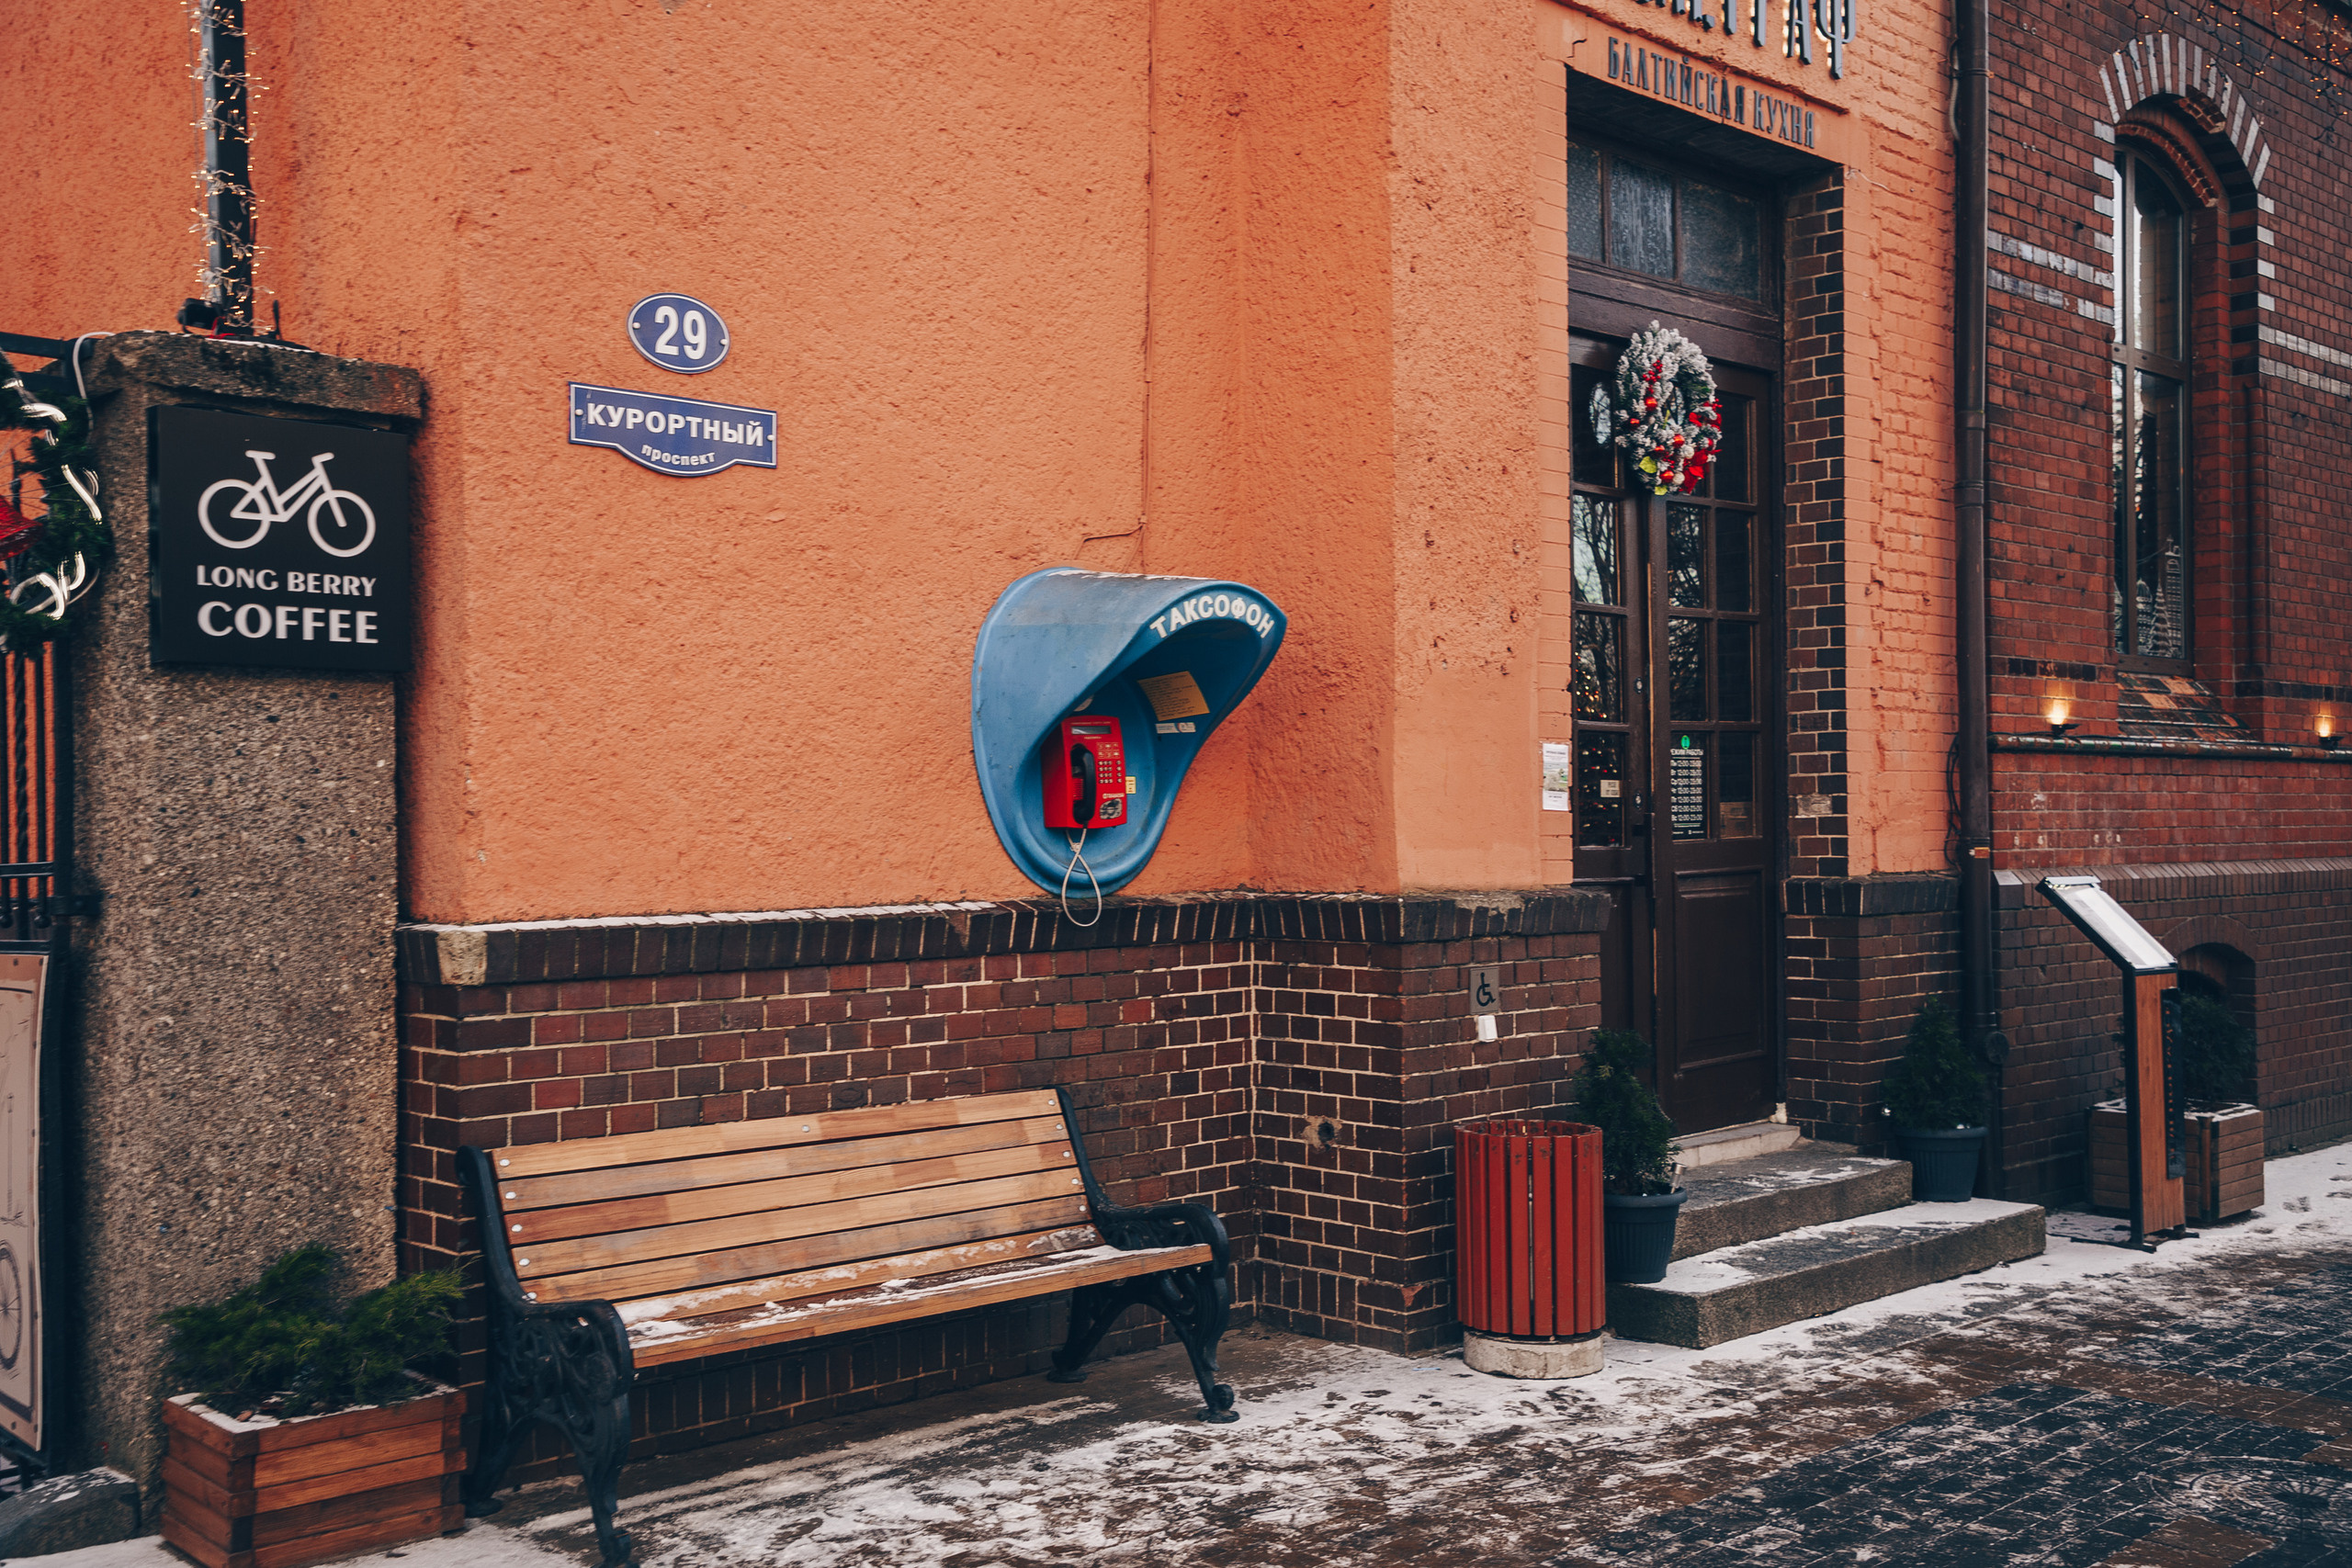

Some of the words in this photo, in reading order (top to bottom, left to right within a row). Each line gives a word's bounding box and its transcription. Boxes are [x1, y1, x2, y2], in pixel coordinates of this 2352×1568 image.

[1608, 36, 1746, 125] БАЛТИЙСКАЯ
[1753, 90, 1815, 149] КУХНЯ
[654, 305, 707, 360] 29
[587, 402, 763, 446] КУРОРТНЫЙ
[641, 444, 716, 466] проспект
[197, 565, 279, 591] LONG
[287, 571, 377, 597] BERRY
[197, 601, 379, 644] COFFEE
[1149, 594, 1275, 638] ТАКСОФОН
